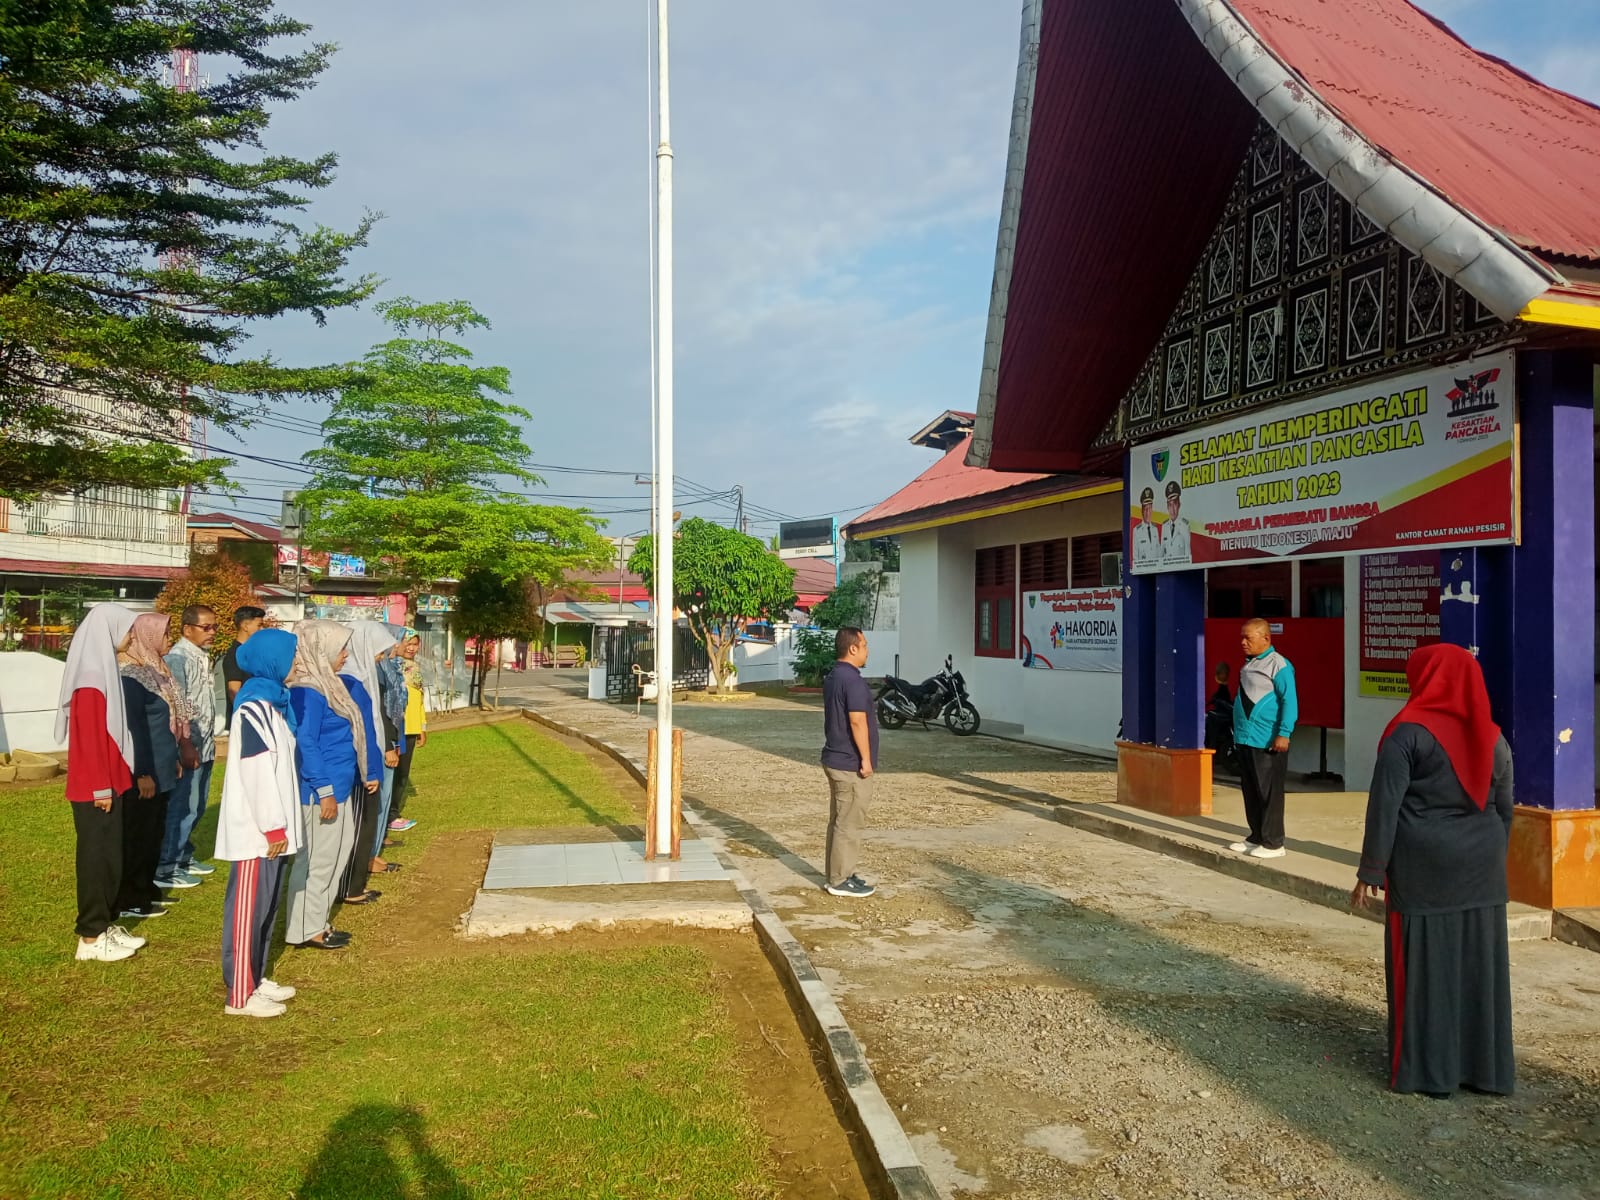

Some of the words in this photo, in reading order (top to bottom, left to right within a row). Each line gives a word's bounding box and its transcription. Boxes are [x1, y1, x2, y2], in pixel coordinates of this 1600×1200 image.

[1180, 425, 1256, 466] SELAMAT
[1259, 386, 1428, 448] MEMPERINGATI
[1445, 422, 1501, 440] PANCASILA
[1451, 416, 1494, 430] KESAKTIAN
[1182, 462, 1215, 489] HARI
[1218, 443, 1307, 482] KESAKTIAN
[1311, 420, 1424, 465] PANCASILA
[1237, 479, 1293, 509] TAHUN
[1296, 471, 1341, 500] 2023
[1330, 501, 1380, 521] BANGSA
[1220, 534, 1258, 551] MENUJU
[1261, 528, 1322, 548] INDONESIA
[1395, 530, 1422, 540] KANTOR
[1423, 528, 1448, 537] CAMAT
[1448, 526, 1474, 535] RANAH
[1475, 523, 1505, 532] PESISIR
[1065, 620, 1117, 636] HAKORDIA
